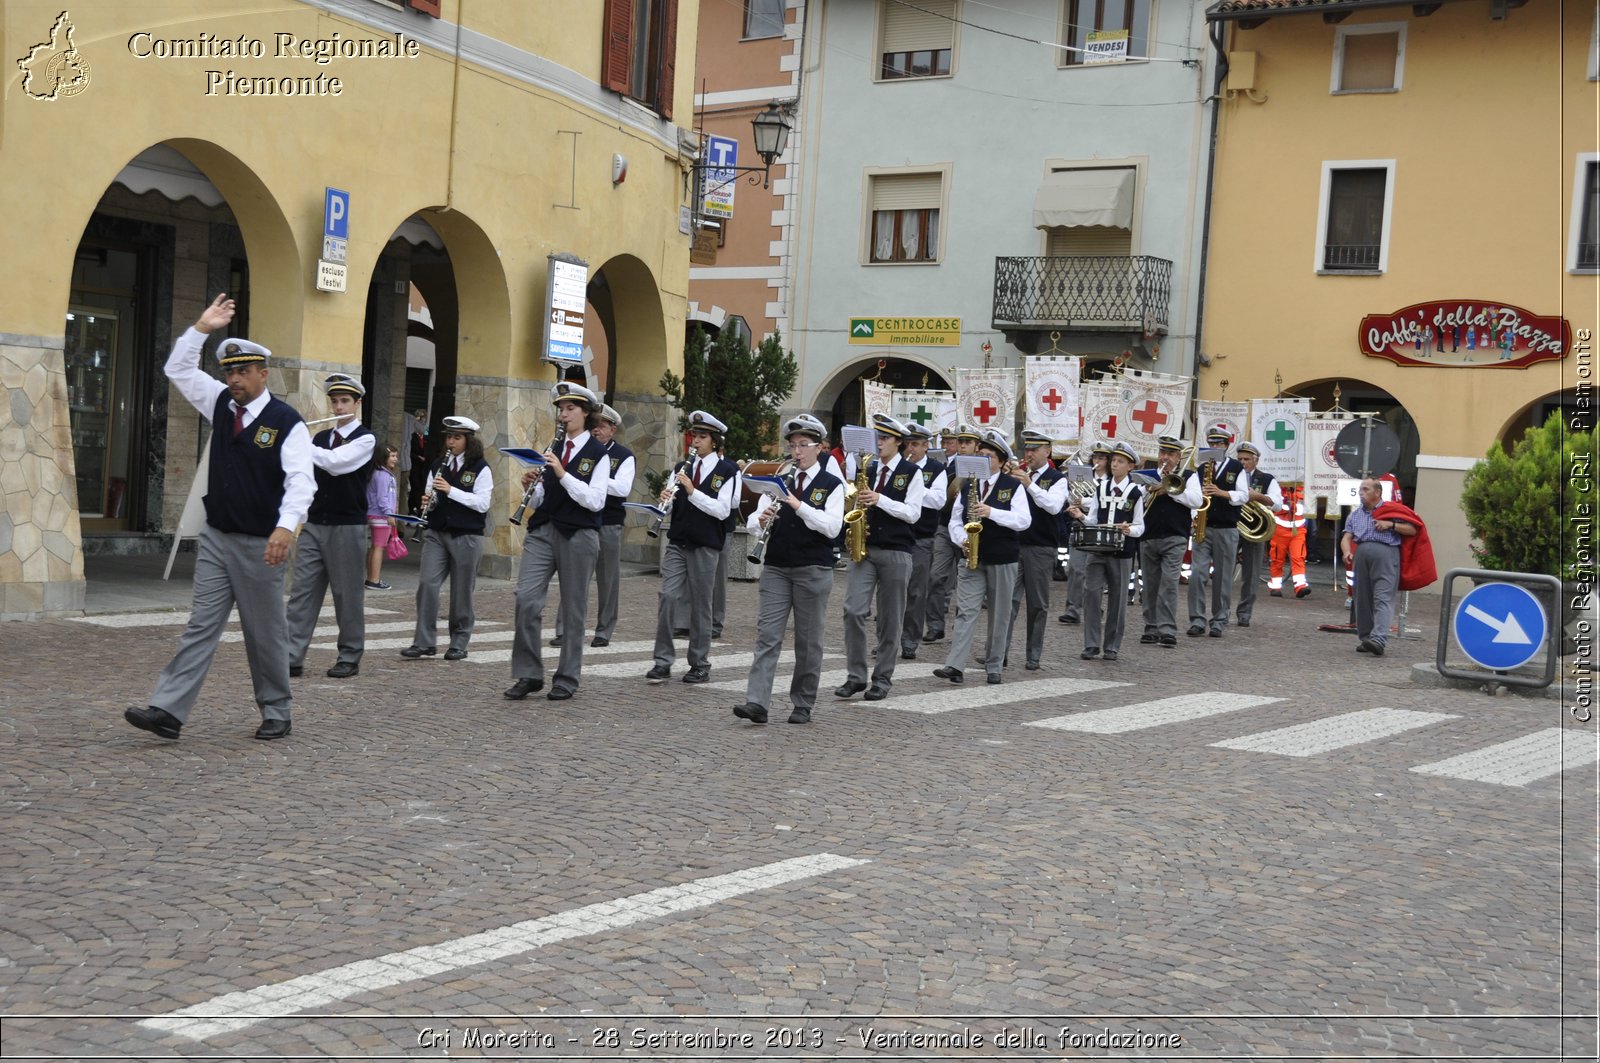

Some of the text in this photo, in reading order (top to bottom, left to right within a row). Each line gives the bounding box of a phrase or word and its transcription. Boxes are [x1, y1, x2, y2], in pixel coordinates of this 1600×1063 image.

[1088, 41, 1125, 52] VENDESI
[714, 142, 733, 169] T
[330, 195, 344, 231] P
[321, 266, 344, 277] escluso
[323, 276, 341, 289] festivi
[876, 319, 959, 330] CENTROCASE
[1433, 306, 1488, 326] della
[1498, 308, 1562, 354] Piazza
[890, 334, 945, 344] Immobiliare
